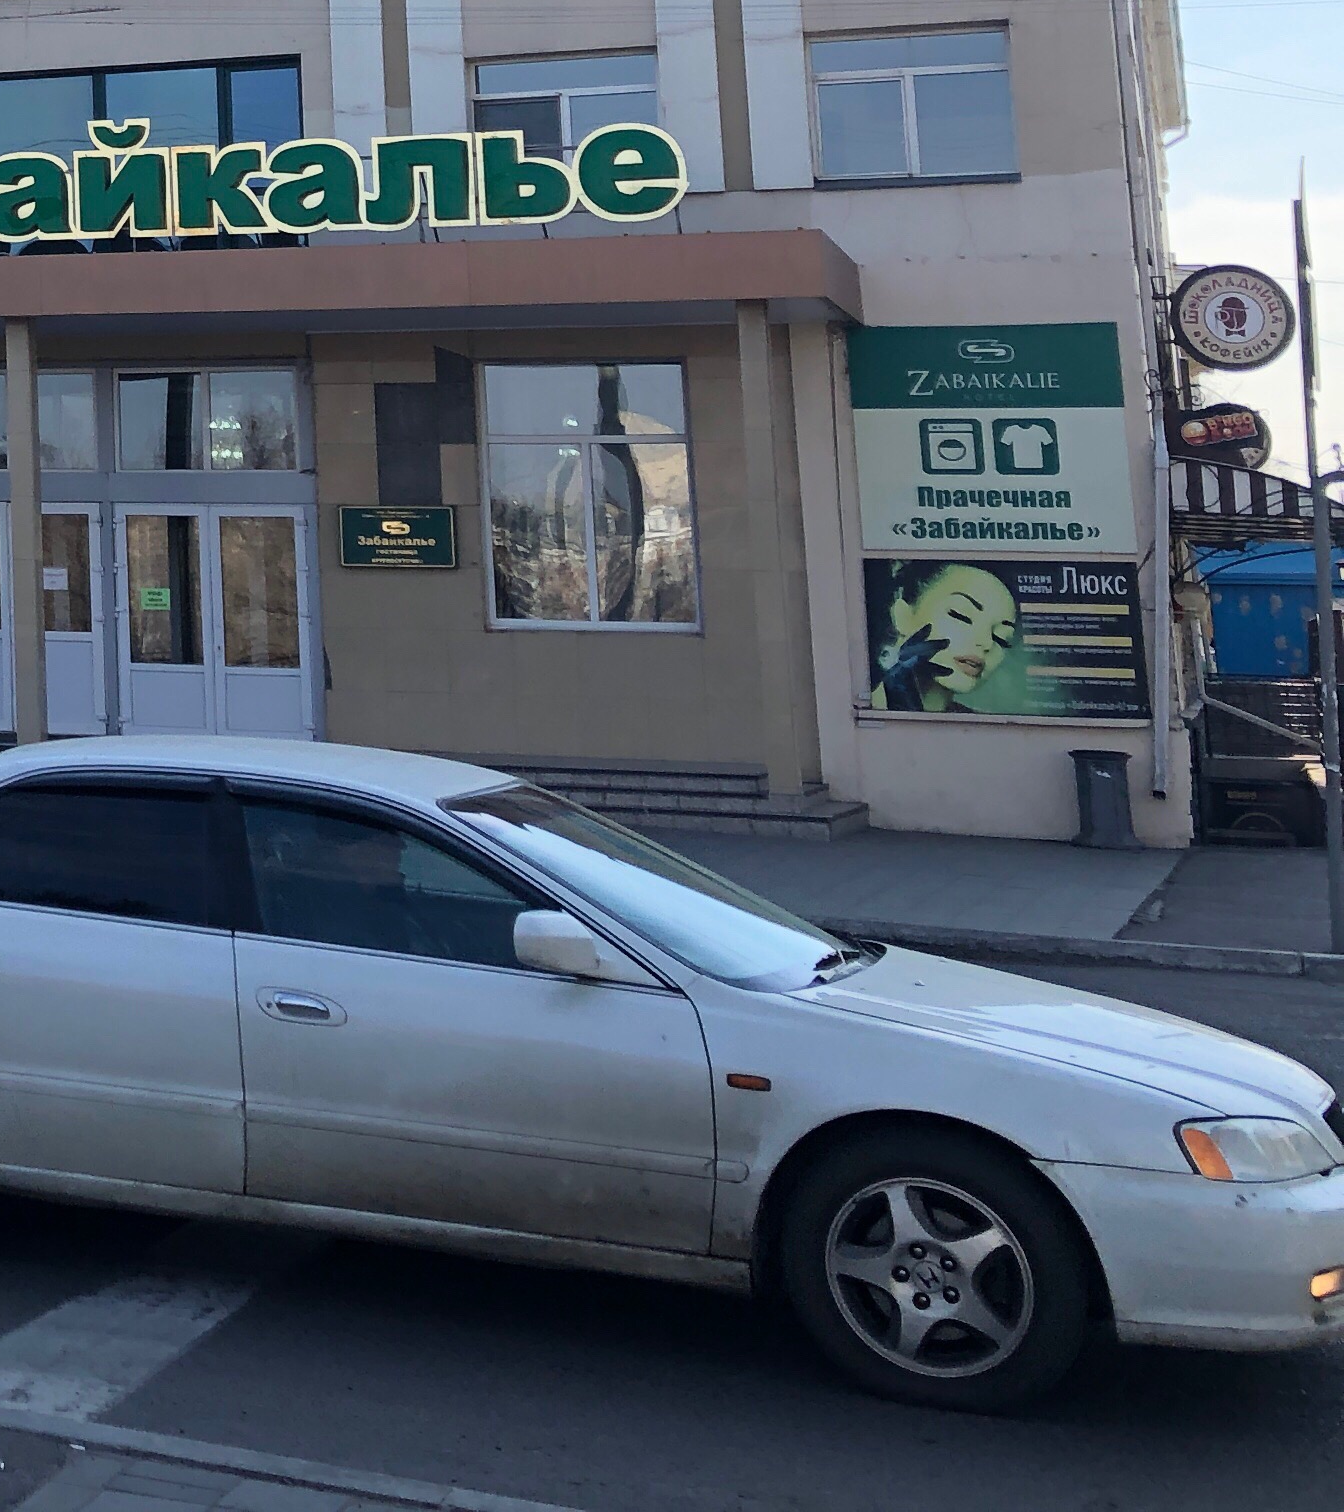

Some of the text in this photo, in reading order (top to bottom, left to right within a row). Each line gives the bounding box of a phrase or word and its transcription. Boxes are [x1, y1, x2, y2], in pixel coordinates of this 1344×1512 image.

[1184, 275, 1283, 325] ШОКОЛАДНИЦА
[1198, 336, 1273, 359] КОФЕЙНЯ
[907, 370, 1061, 396] ZABAIKALIE
[917, 486, 1072, 509] Прачечная
[892, 517, 1101, 541] «Забайкалье»
